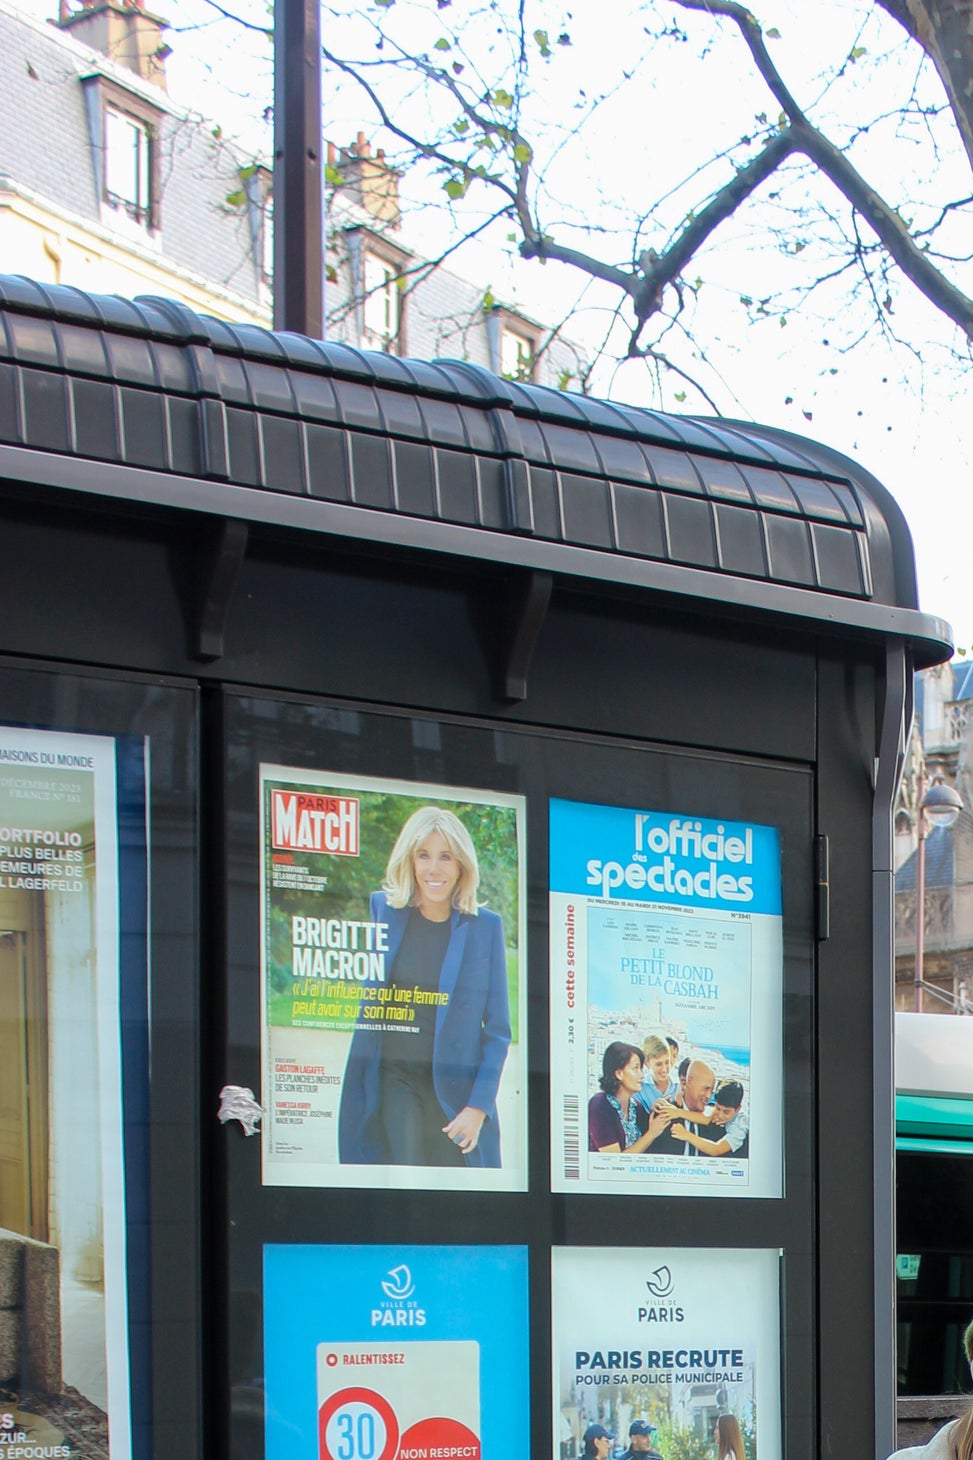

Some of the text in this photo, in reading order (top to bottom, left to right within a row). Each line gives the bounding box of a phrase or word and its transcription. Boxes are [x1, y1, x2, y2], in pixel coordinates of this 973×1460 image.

[0, 749, 94, 768] AISONS DU MONDE
[297, 796, 337, 812] PARIS
[275, 794, 357, 853] MATCH
[635, 814, 753, 865] l'officiel
[35, 848, 83, 862] BELLES
[632, 853, 648, 863] des
[65, 866, 82, 877] DE
[586, 856, 754, 902] spectacles
[8, 878, 82, 892] LAGERFELD
[292, 916, 389, 951] BRIGITTE
[564, 904, 575, 1009] cette semaine
[652, 948, 664, 959] LE
[292, 947, 385, 982] MACRON
[620, 957, 714, 982] PETIT BLOND
[413, 985, 449, 1005] femme
[630, 974, 719, 1000] DE LA CASBAH
[292, 1001, 316, 1018] peut
[318, 1001, 342, 1016] avoir
[344, 1004, 362, 1018] sur
[363, 1005, 384, 1019] son
[371, 1309, 427, 1327] PARIS
[638, 1307, 685, 1322] PARIS
[343, 1353, 405, 1365] RALENTISSEZ
[575, 1350, 743, 1370] PARIS RECRUTE
[576, 1372, 743, 1386] POUR SA POLICE MUNICIPALE
[337, 1412, 375, 1460] 30
[7, 1445, 71, 1460] ÉPOQUES
[400, 1446, 478, 1459] NON RESPECT
